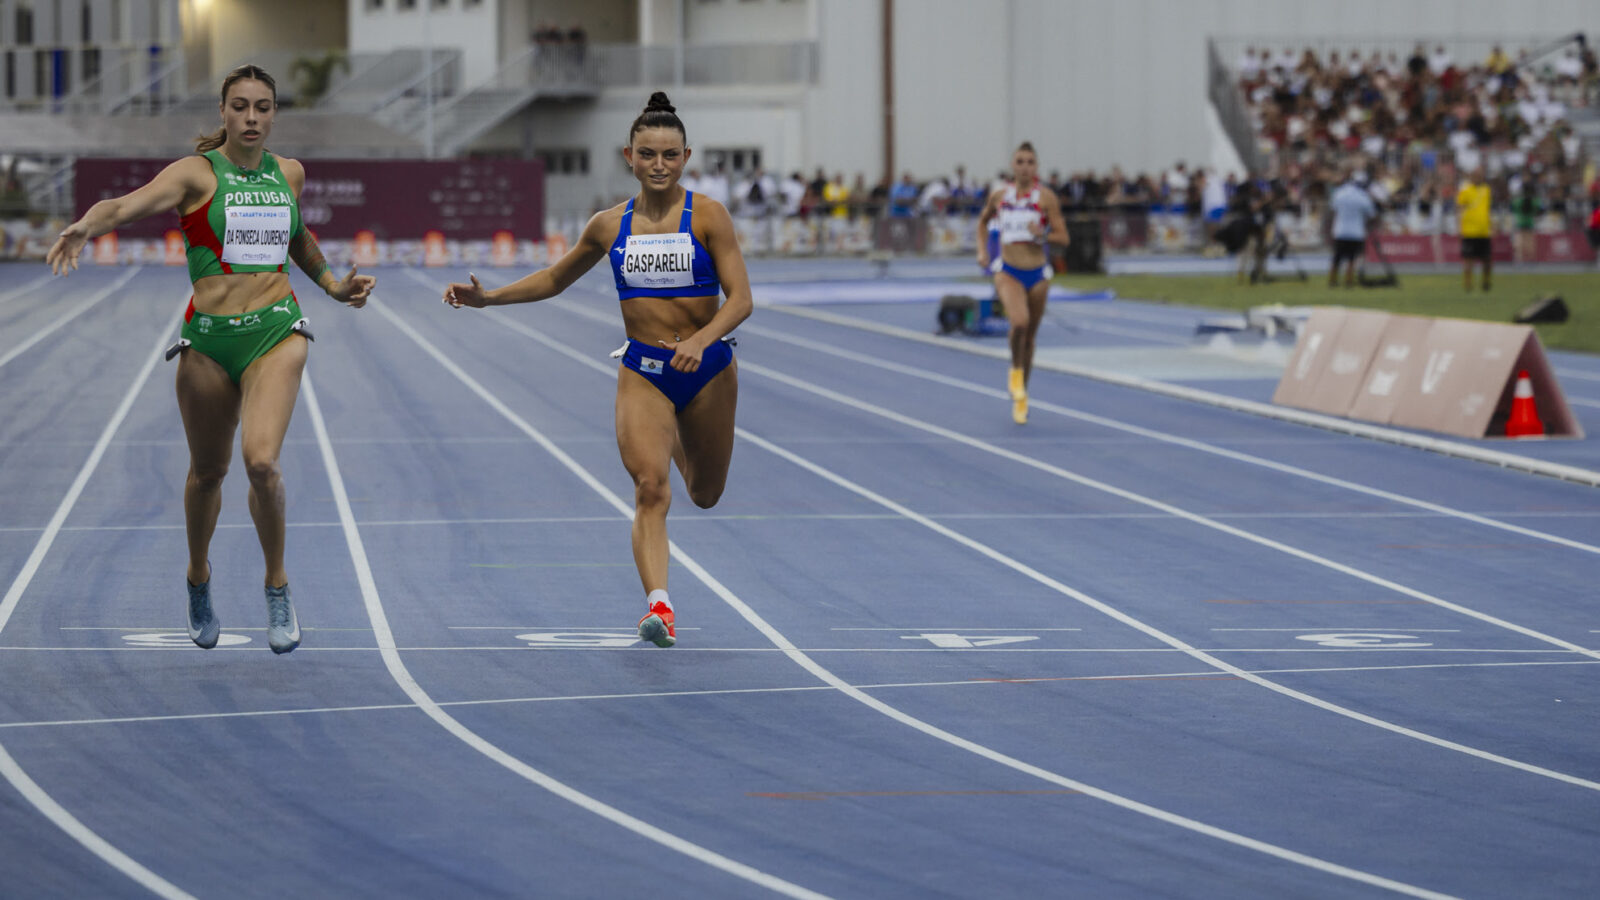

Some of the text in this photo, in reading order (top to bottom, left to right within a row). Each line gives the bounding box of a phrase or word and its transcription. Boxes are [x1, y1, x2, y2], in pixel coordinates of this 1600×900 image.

[224, 191, 294, 206] PORTUGAL
[226, 229, 289, 249] DA FONSECA LOURENÇO
[626, 253, 691, 273] GASPARELLI
[243, 314, 262, 326] CA
[515, 632, 643, 647] 5
[899, 633, 1041, 648] 4
[1295, 633, 1433, 648] 3
